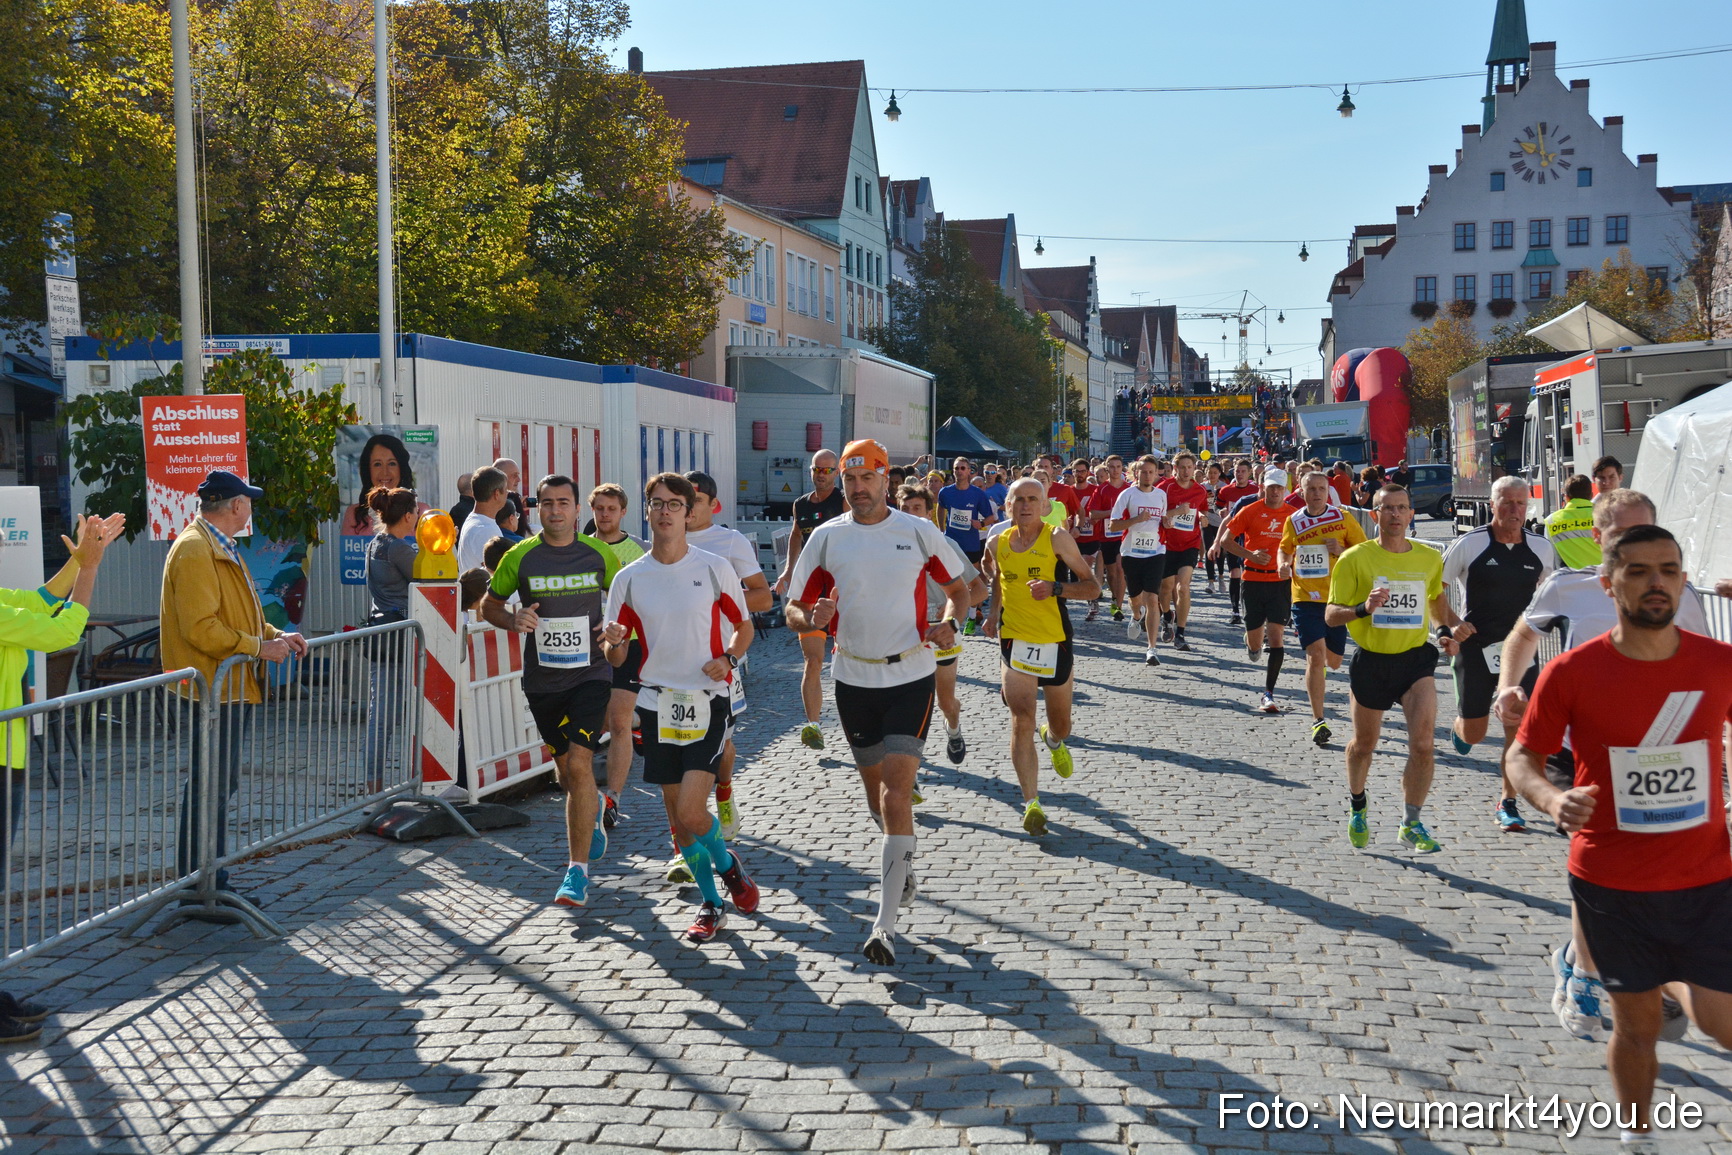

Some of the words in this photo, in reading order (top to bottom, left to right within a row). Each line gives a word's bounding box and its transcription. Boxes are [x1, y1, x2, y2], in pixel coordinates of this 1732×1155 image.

[50, 291, 77, 303] Parkschein
[53, 304, 76, 315] werktags
[1184, 399, 1220, 408] START
[152, 405, 239, 421] Abschluss
[152, 422, 181, 431] statt
[153, 432, 240, 446] Ausschluss!
[169, 455, 194, 463] Mehr
[195, 453, 224, 463] Lehrer
[226, 452, 238, 462] für
[165, 465, 202, 474] kleinere
[204, 464, 239, 473] Klassen.
[1297, 531, 1318, 543] MAX
[1321, 523, 1346, 535] BÖGL
[1135, 538, 1154, 546] 2147
[1299, 554, 1323, 564] 2415
[345, 569, 367, 579] CSU
[1028, 567, 1041, 575] MTP
[528, 573, 598, 591] BOCK
[542, 632, 582, 647] 2535
[937, 648, 955, 657] Herbert
[1026, 647, 1041, 660] 71
[1022, 664, 1042, 673] Werner
[672, 704, 696, 721] 304
[1638, 752, 1682, 763] BOCK
[1627, 767, 1697, 796] 2622
[1643, 810, 1687, 822] Mensur
